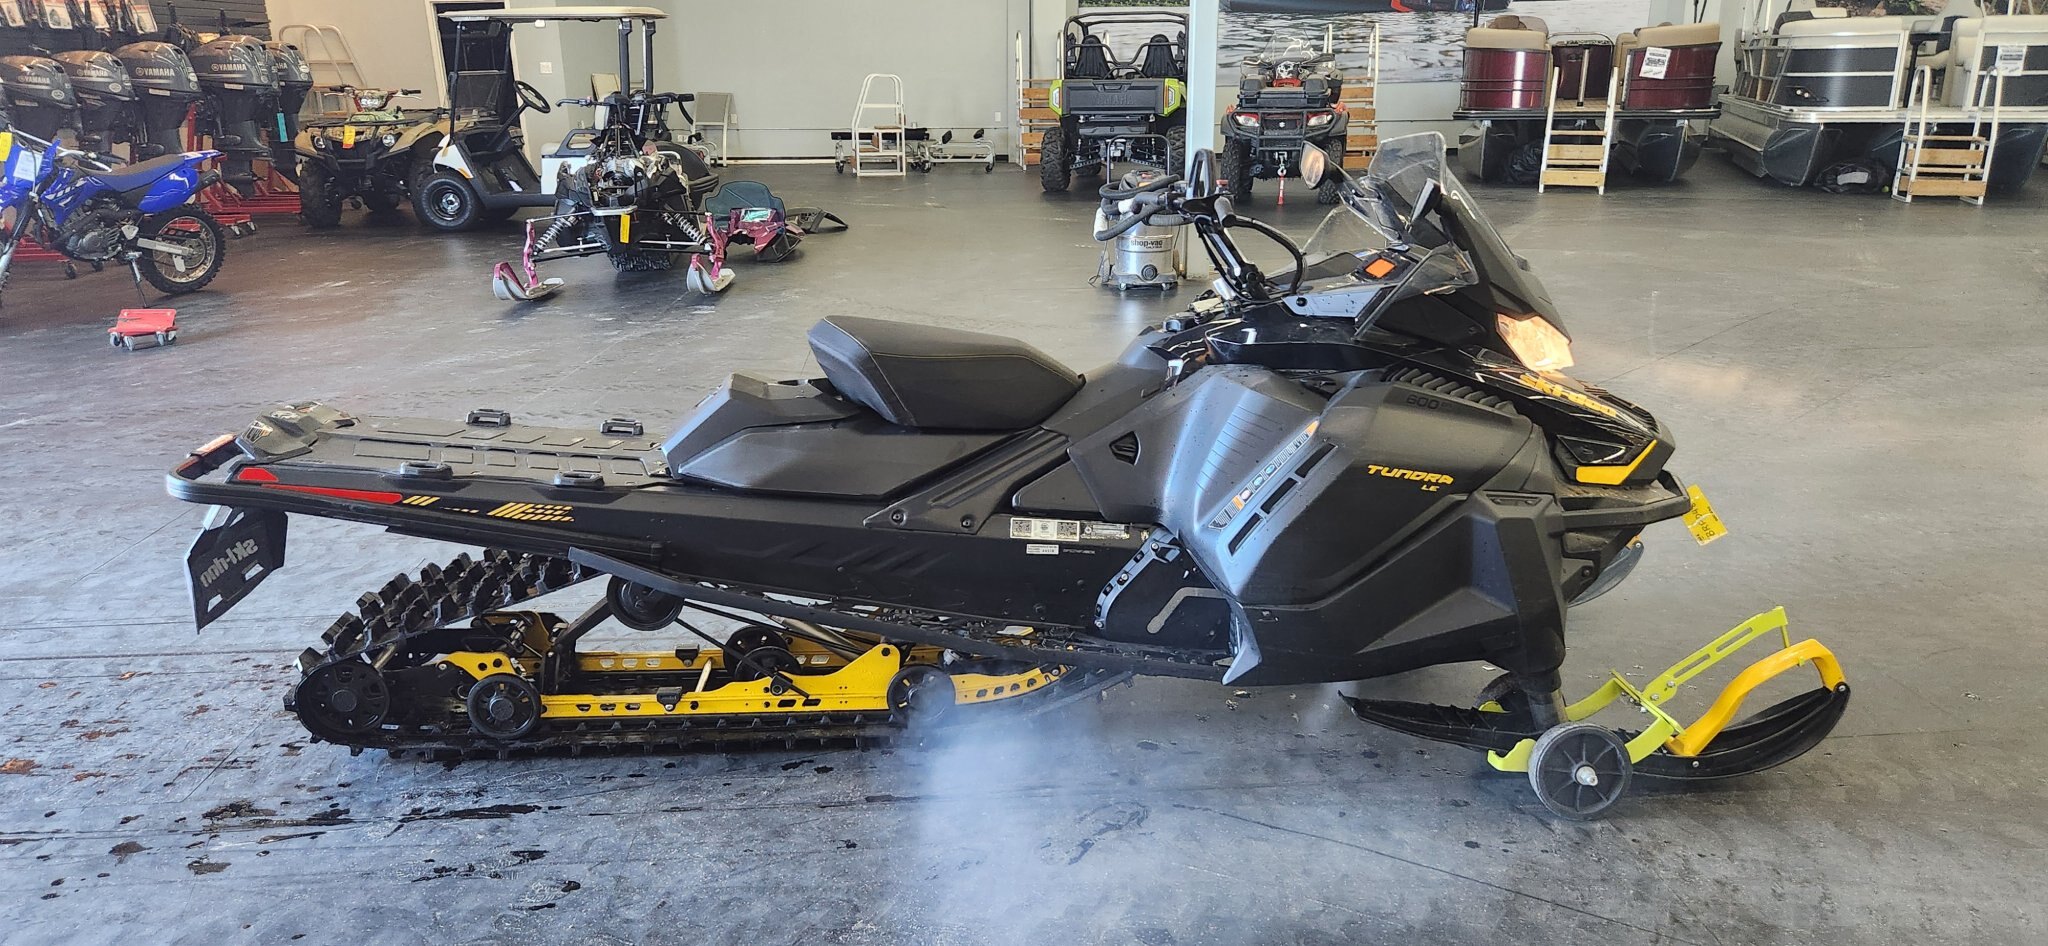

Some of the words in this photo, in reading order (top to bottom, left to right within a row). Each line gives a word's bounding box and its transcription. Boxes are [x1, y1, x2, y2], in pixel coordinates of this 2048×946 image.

[143, 67, 175, 77] YAMAHA
[218, 63, 247, 72] YAMAHA
[83, 69, 109, 77] YAMAHA
[24, 75, 51, 84] YAMAHA
[1407, 394, 1440, 409] 600
[1367, 464, 1454, 485] TUNDRA
[1421, 484, 1440, 492] LE
